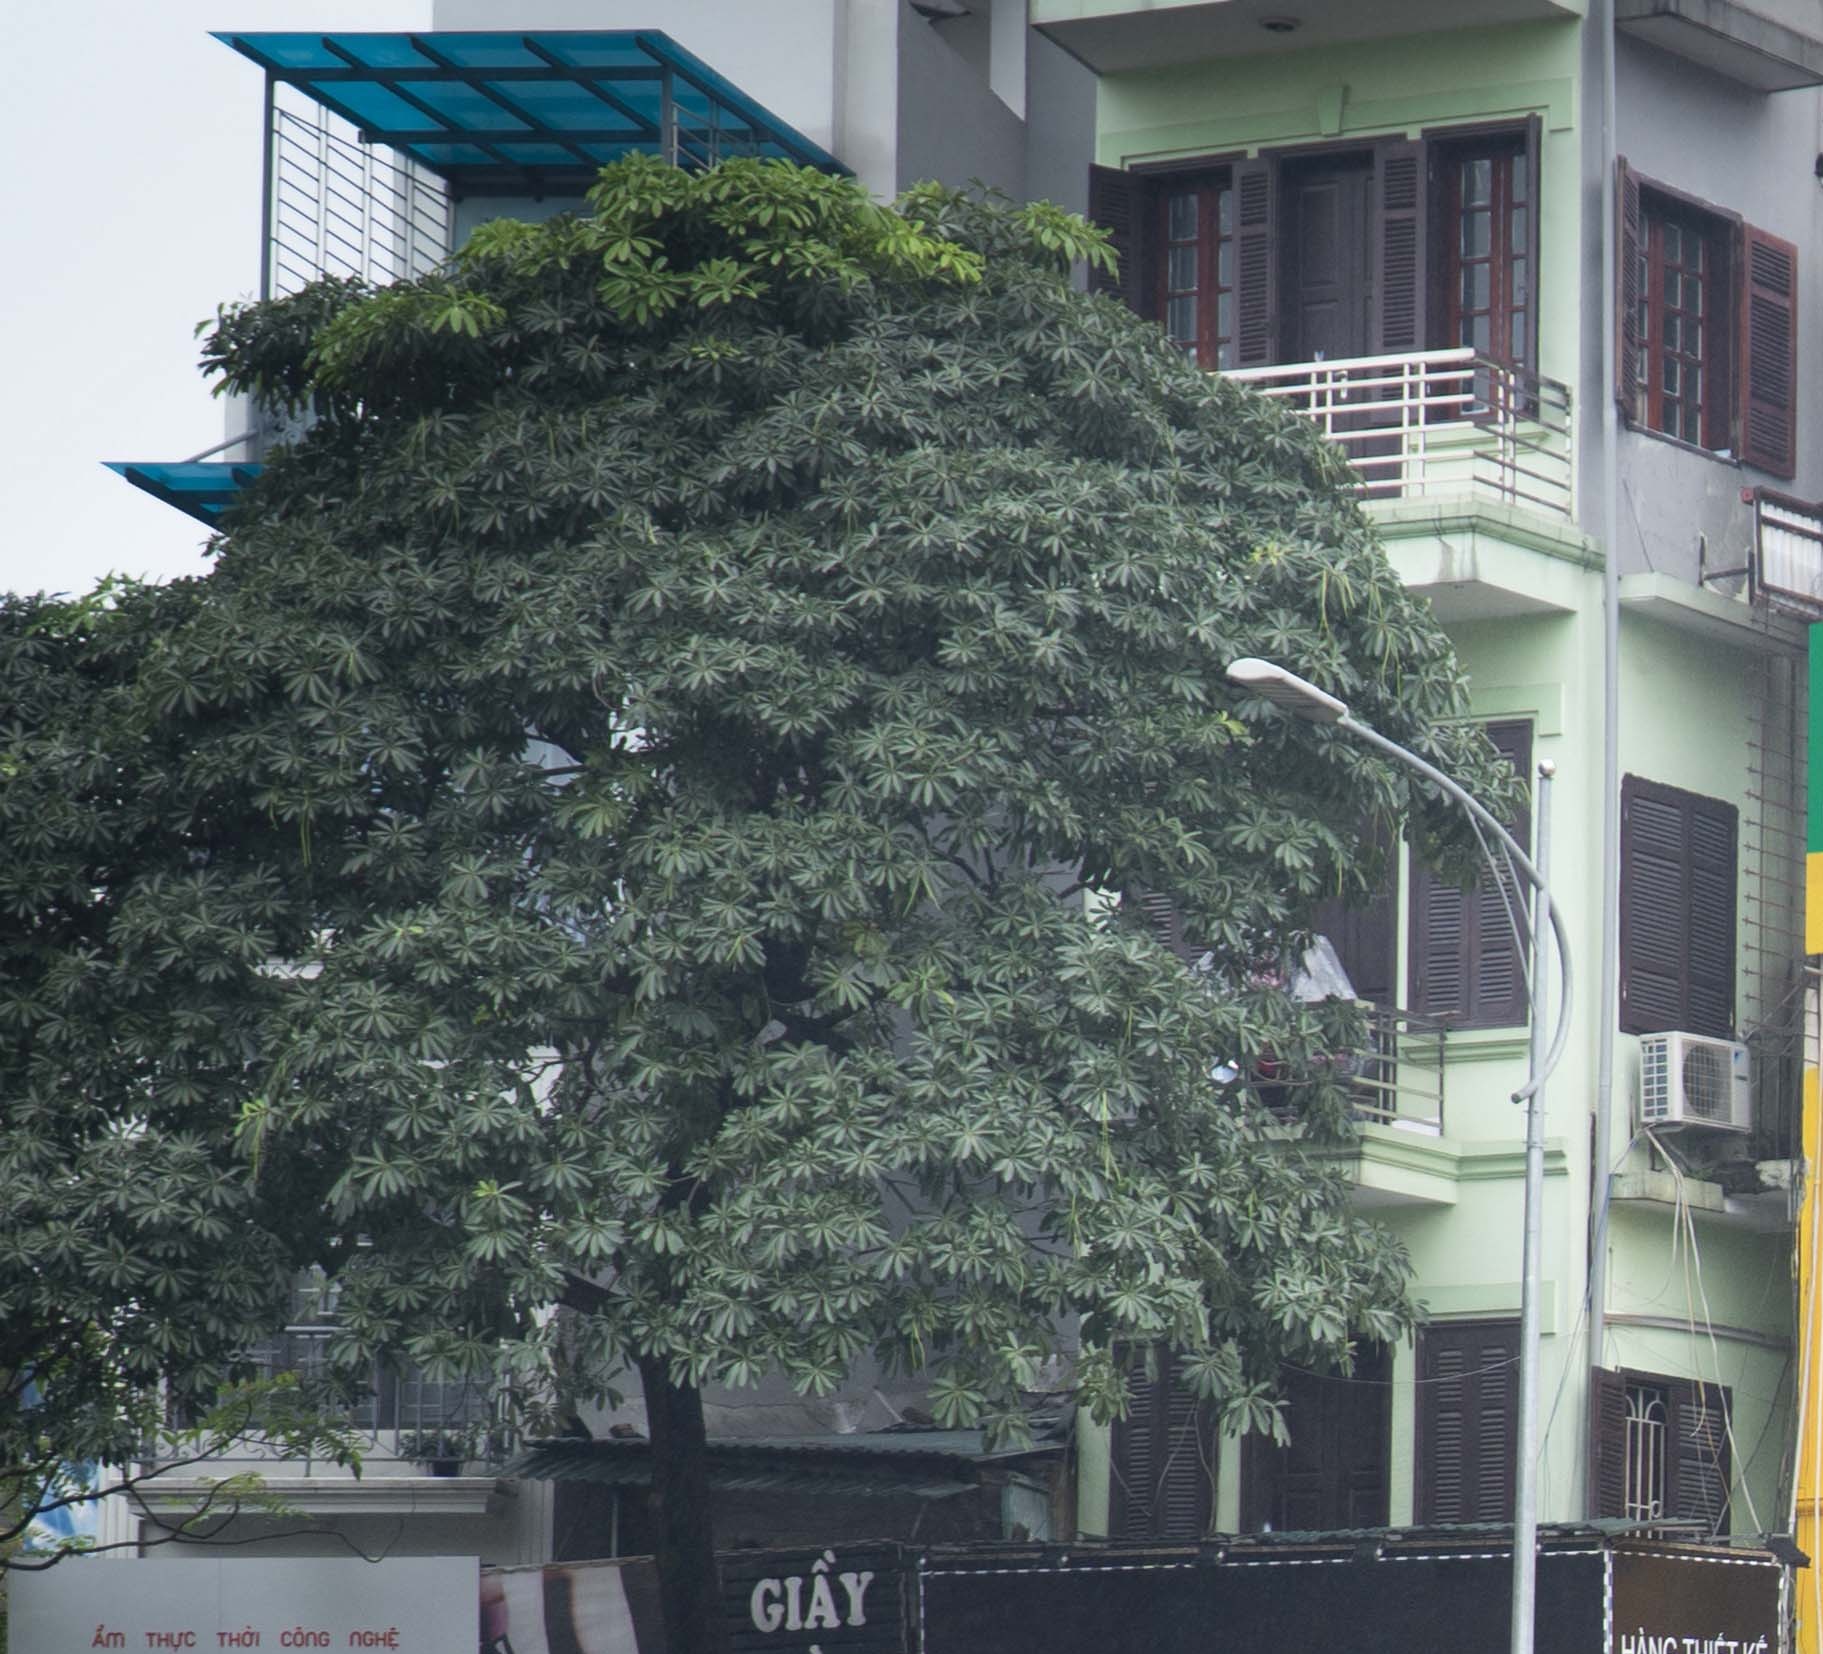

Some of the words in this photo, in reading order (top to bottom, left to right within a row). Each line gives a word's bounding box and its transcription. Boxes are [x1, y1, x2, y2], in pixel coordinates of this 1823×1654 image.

[751, 1549, 874, 1632] GIẦY
[146, 1630, 197, 1652] THỰC
[217, 1628, 261, 1648] THỜI
[280, 1629, 330, 1648] CÔNG
